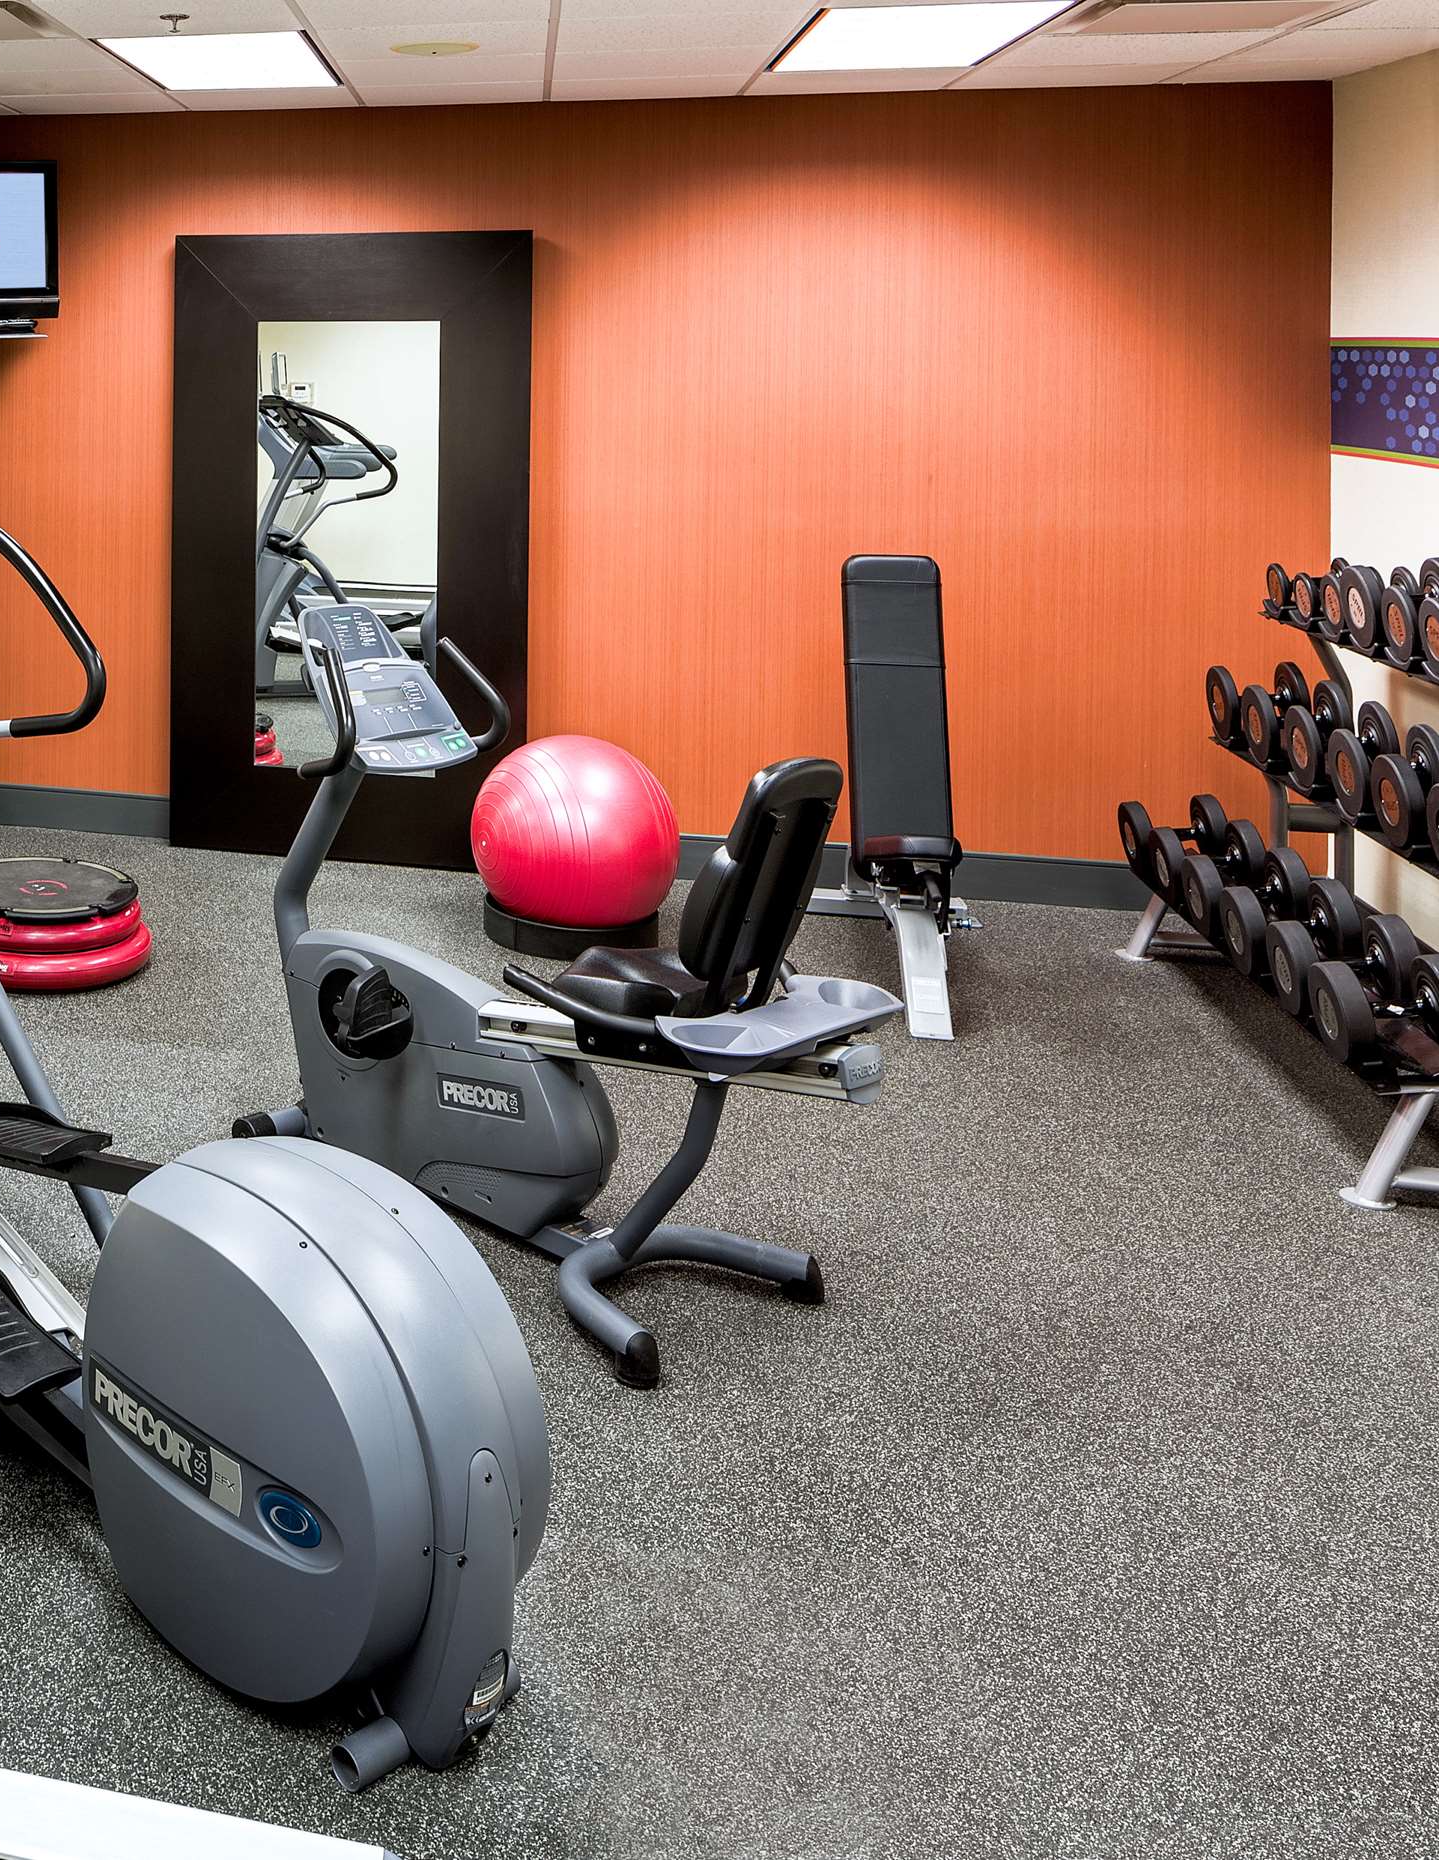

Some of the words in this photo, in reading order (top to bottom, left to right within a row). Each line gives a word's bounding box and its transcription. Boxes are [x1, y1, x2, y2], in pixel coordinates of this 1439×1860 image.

[442, 1080, 510, 1113] PRECOR
[509, 1092, 519, 1114] USA
[95, 1368, 193, 1478] PRECOR
[193, 1449, 207, 1486] USA
[214, 1471, 236, 1494] EFX
